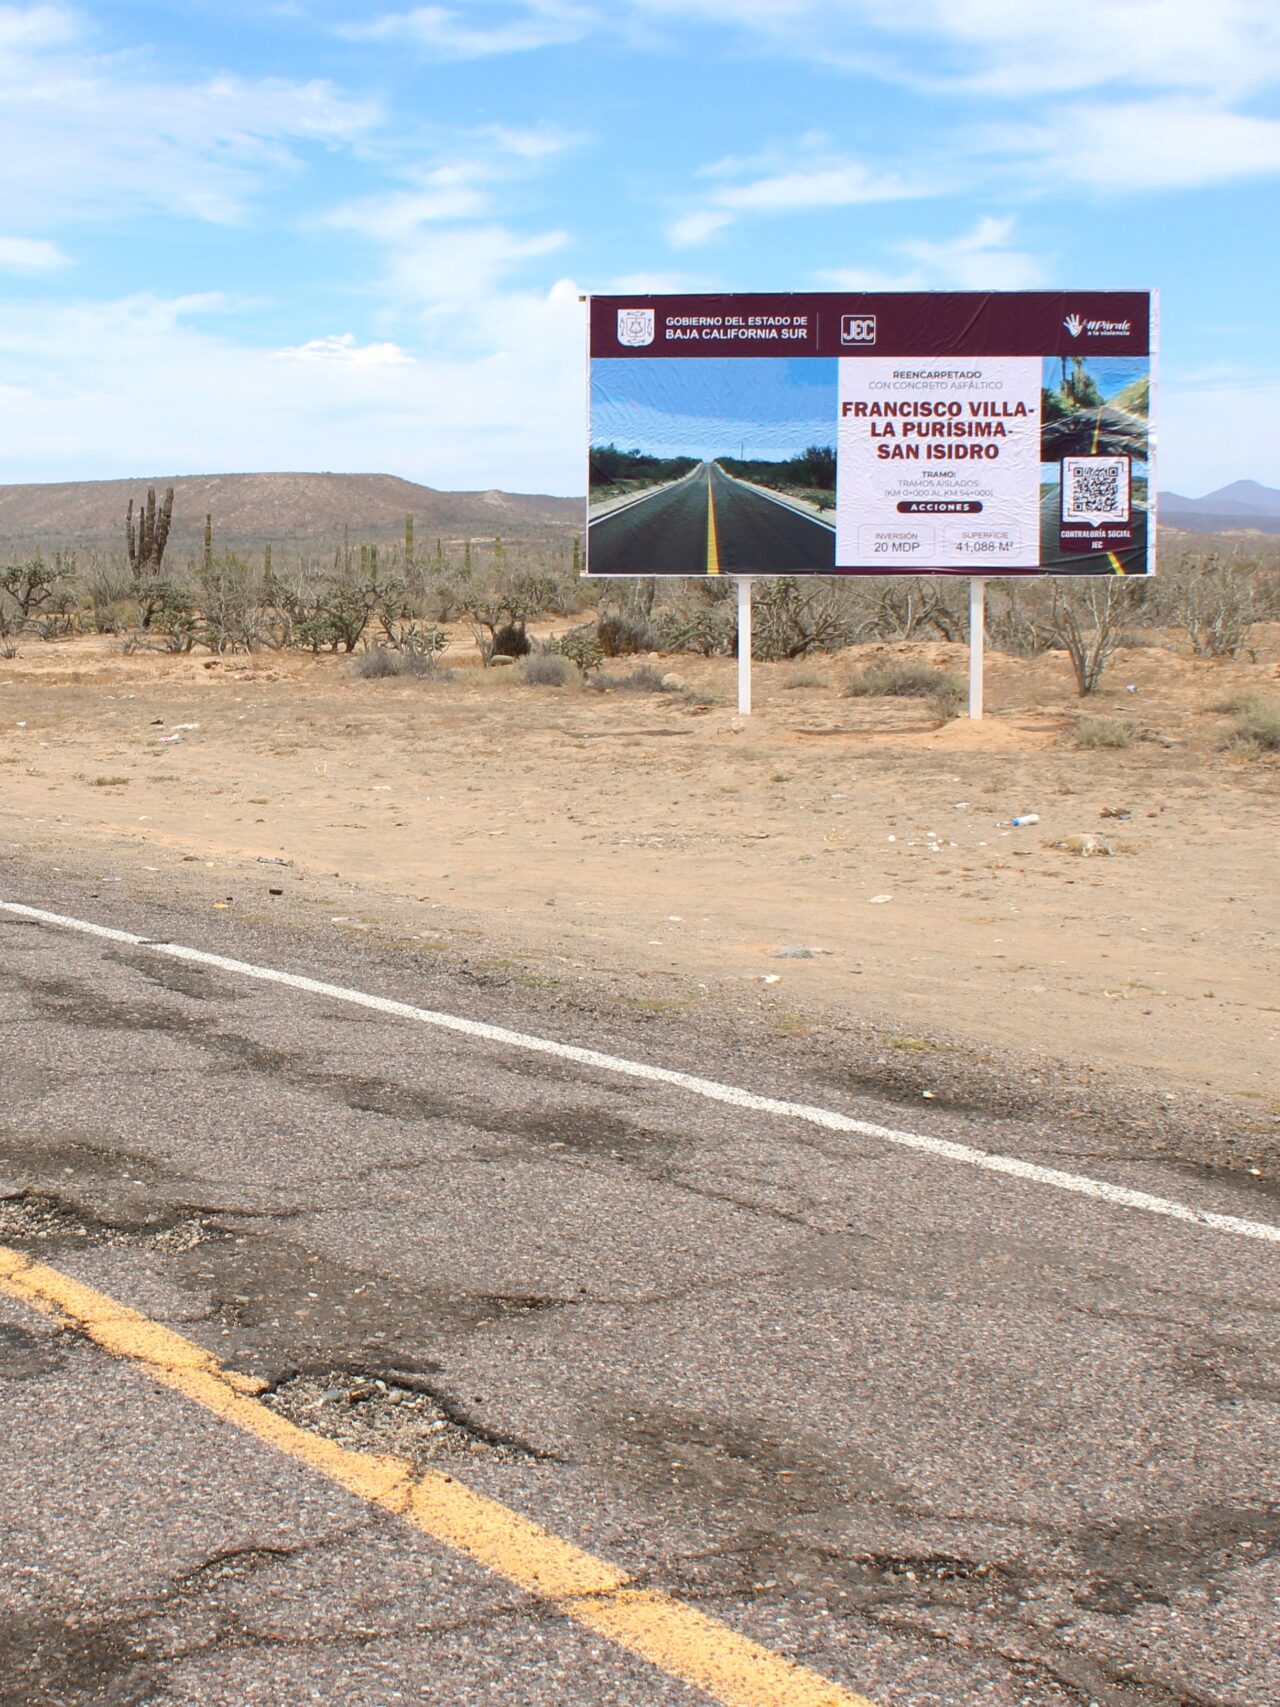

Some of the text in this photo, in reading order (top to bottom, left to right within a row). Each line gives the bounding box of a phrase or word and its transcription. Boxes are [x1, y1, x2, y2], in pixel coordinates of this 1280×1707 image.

[666, 316, 807, 326] GOBIERNO DEL ESTADO DE
[666, 328, 807, 339] BAJA CALIFORNIA SUR
[893, 371, 982, 379] REENCARPETADO
[868, 380, 1002, 390] CON CONCRETO ASFÁLTICO
[842, 402, 1034, 417] FRANCISCO VILLA-
[870, 422, 896, 437] LA
[877, 444, 999, 460] SAN ISIDRO
[875, 531, 918, 540] INVERSIÓN
[1061, 529, 1132, 538] CONTRALORÍA SOCIAL
[874, 542, 920, 552] 20 MDP
[956, 542, 995, 553] 41,088
[1091, 541, 1103, 549] JEC
